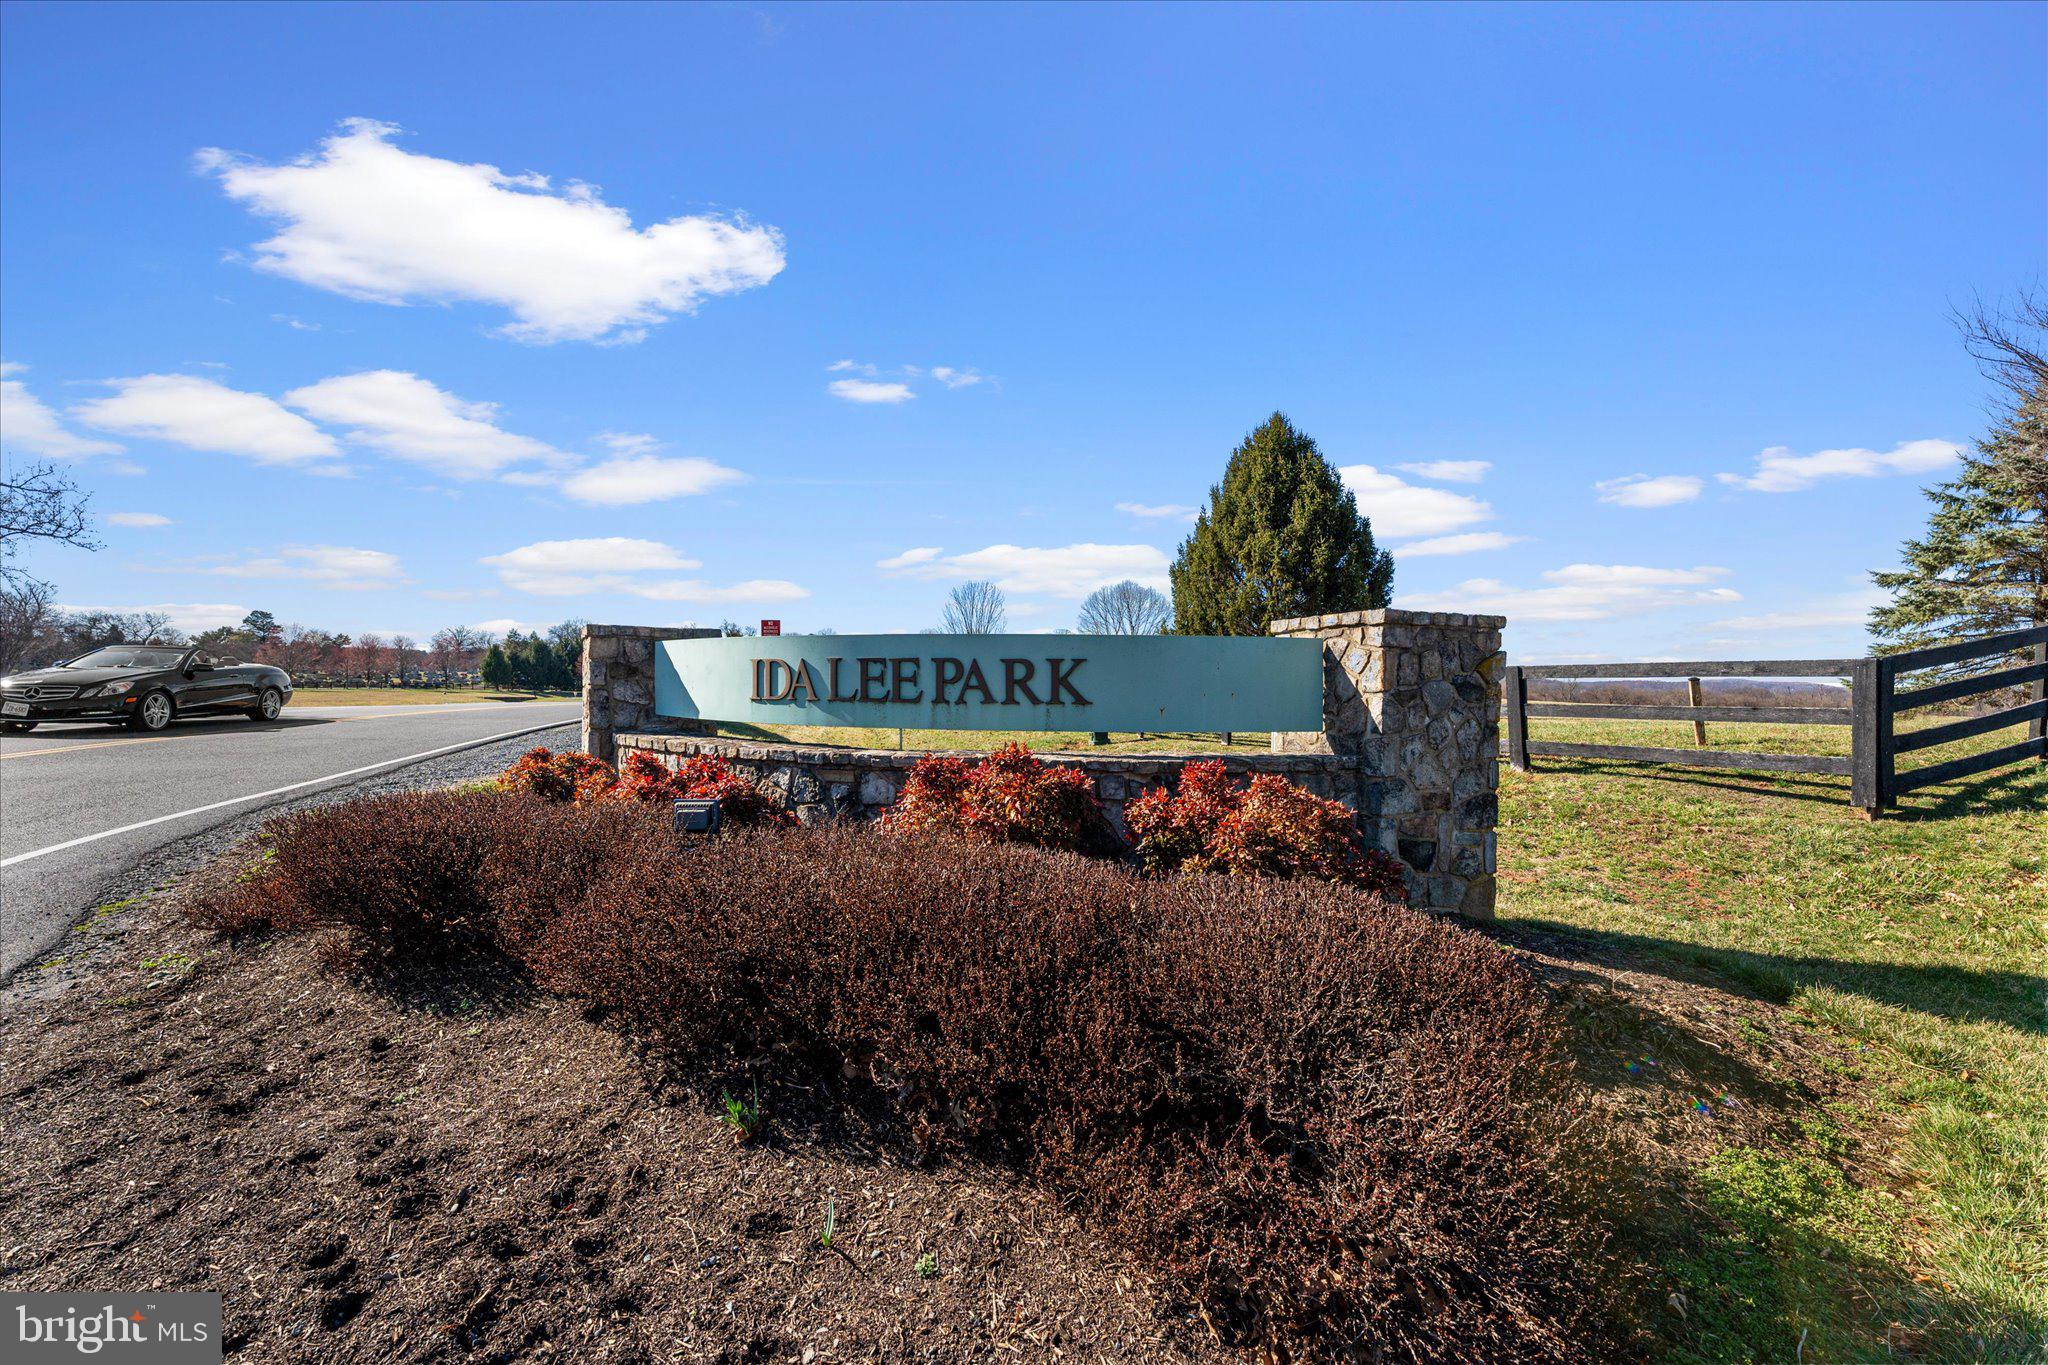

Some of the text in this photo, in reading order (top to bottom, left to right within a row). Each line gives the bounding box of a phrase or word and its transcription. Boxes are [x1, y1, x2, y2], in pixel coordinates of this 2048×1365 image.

[750, 657, 1093, 706] IDA LEE PARK
